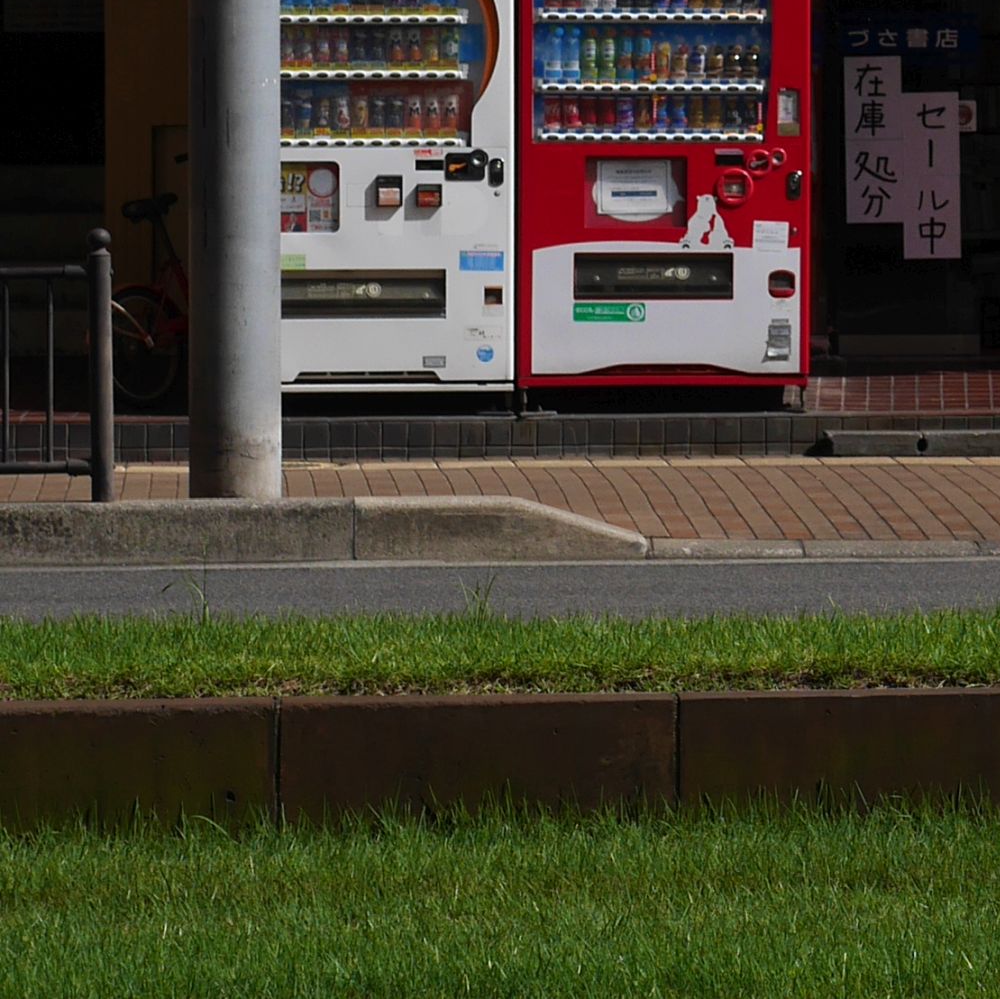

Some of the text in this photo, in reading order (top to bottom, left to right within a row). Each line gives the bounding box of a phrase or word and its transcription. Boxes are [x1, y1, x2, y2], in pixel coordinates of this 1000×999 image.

[848, 29, 959, 49] づさ書店
[853, 63, 898, 218] 在庫処分
[916, 103, 949, 255] セール中
